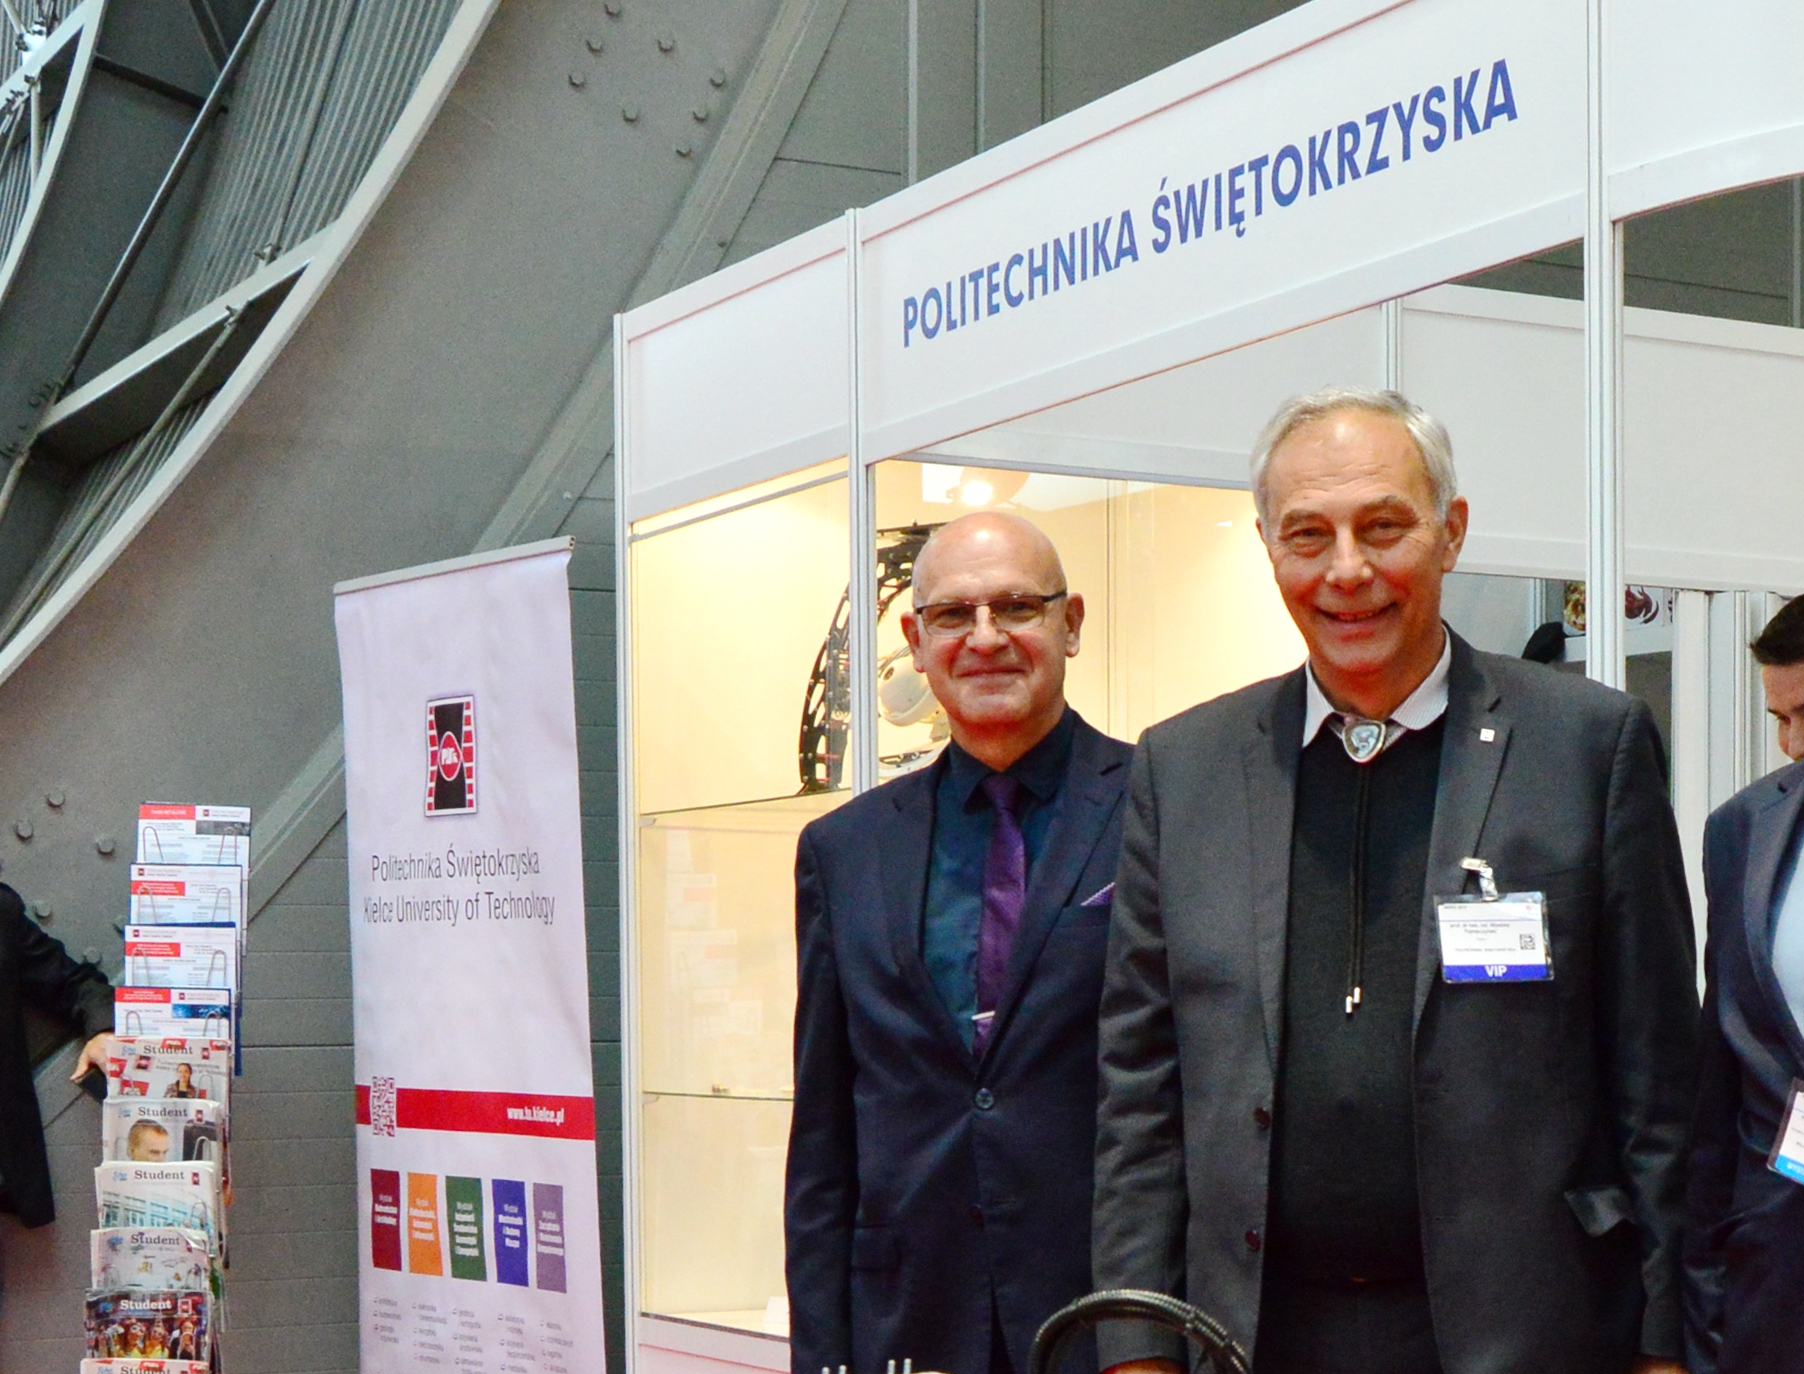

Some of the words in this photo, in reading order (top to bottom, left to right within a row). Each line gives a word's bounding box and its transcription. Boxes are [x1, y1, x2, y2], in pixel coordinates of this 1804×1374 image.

[903, 208, 1138, 348] POLITECHNIKA
[1151, 58, 1518, 254] ŚWIĘTOKRZYSKA
[371, 853, 442, 882] Politechnika
[446, 843, 540, 884] Świętokrzyska
[363, 896, 393, 923] Kielce
[396, 894, 459, 927] University
[465, 893, 480, 920] of
[484, 890, 555, 925] Technology
[1485, 966, 1507, 977] VIP
[143, 1045, 193, 1055] Student
[138, 1106, 188, 1118] Student
[134, 1169, 185, 1180] Student
[130, 1233, 181, 1246] Student
[120, 1299, 172, 1311] Student
